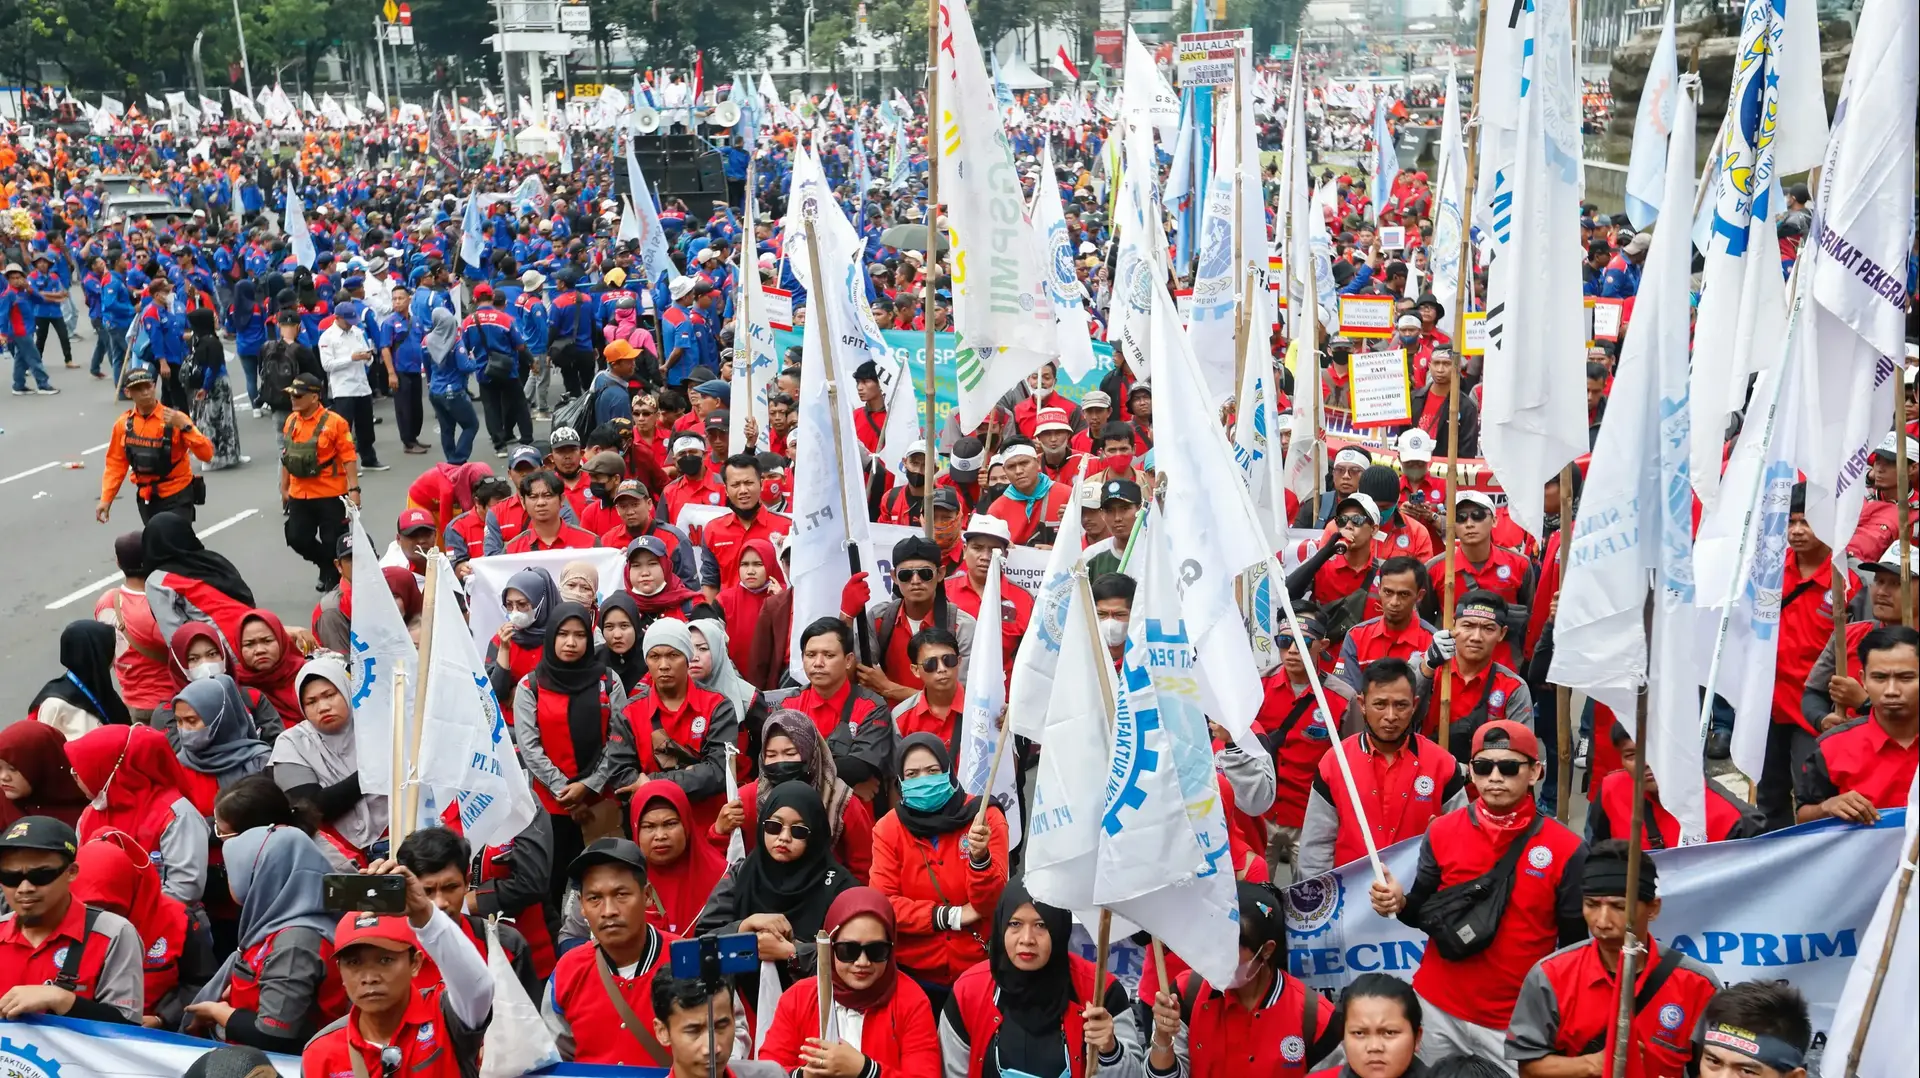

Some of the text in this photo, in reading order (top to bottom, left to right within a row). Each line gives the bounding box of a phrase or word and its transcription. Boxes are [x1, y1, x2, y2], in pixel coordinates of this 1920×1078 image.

[1181, 42, 1209, 52] JUAL
[1820, 223, 1863, 270] ERIKAT
[1381, 393, 1401, 401] LIBUR
